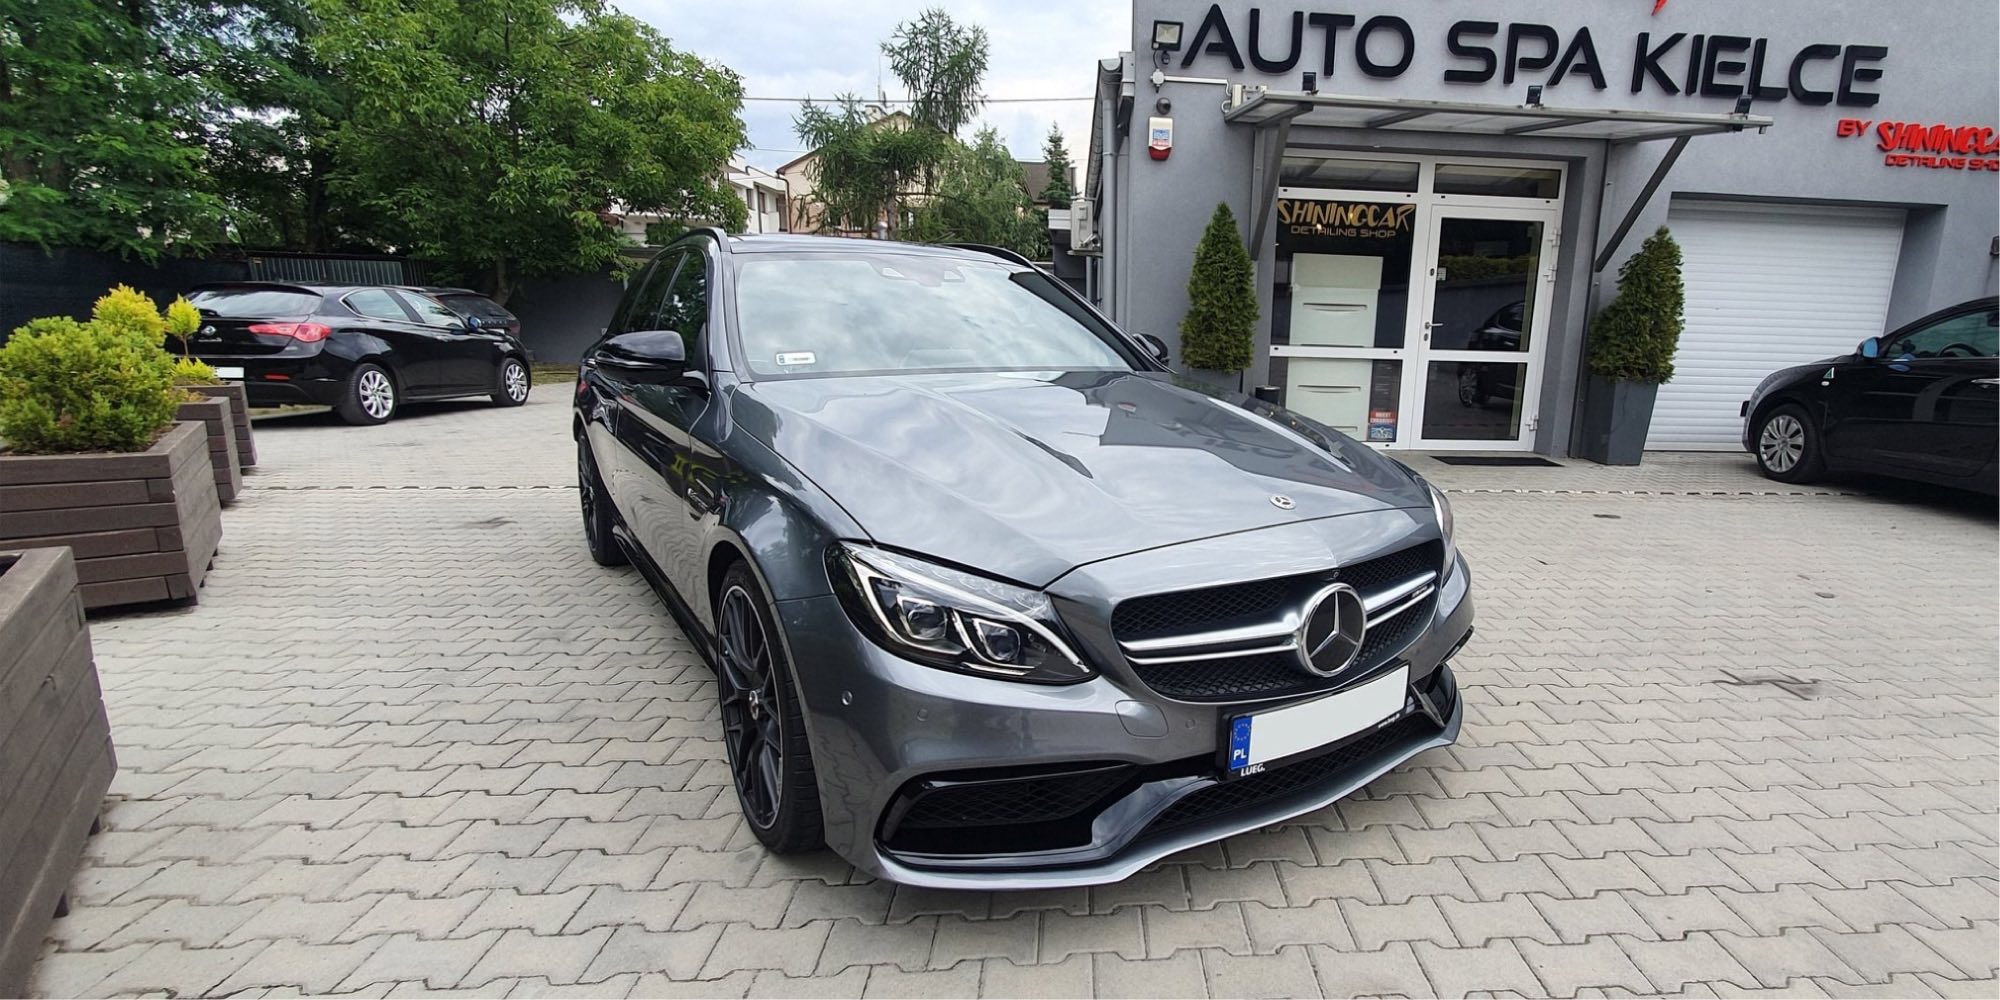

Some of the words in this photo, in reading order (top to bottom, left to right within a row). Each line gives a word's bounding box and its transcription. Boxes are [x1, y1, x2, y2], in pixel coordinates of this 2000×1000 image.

[1181, 3, 1415, 78] AUTO
[1444, 20, 1607, 89] SPA
[1631, 32, 1888, 107] KIELCE
[1836, 118, 1872, 137] BY
[1885, 154, 1966, 169] DETAILING
[1277, 199, 1416, 232] SHININGCAR
[1290, 225, 1357, 237] DETAILING
[1360, 228, 1397, 239] SHOP
[1233, 748, 1248, 761] PL
